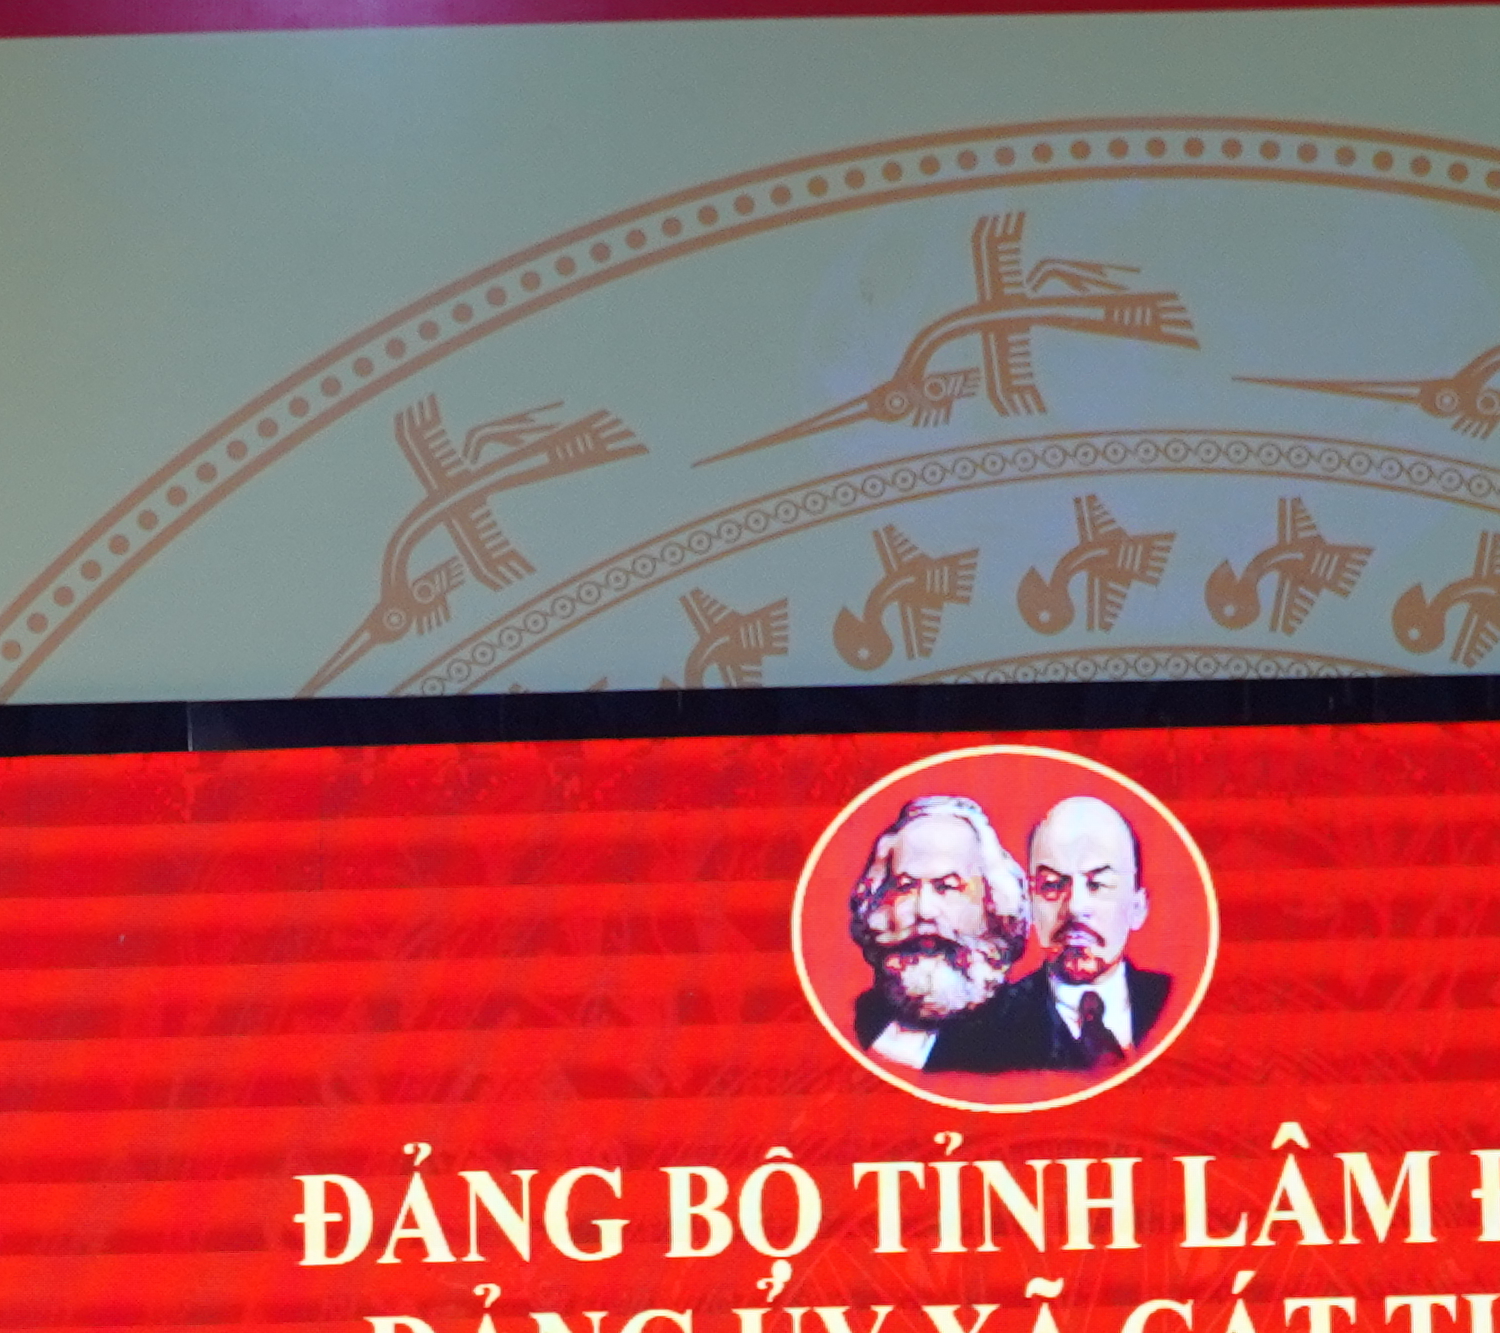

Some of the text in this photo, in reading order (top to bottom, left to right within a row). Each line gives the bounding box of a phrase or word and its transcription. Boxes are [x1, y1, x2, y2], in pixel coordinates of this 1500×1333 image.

[294, 1143, 629, 1265] ĐẢNG
[661, 1147, 822, 1283] BỘ
[853, 1132, 1141, 1253] TỈNH
[1175, 1122, 1438, 1247] LÂM
